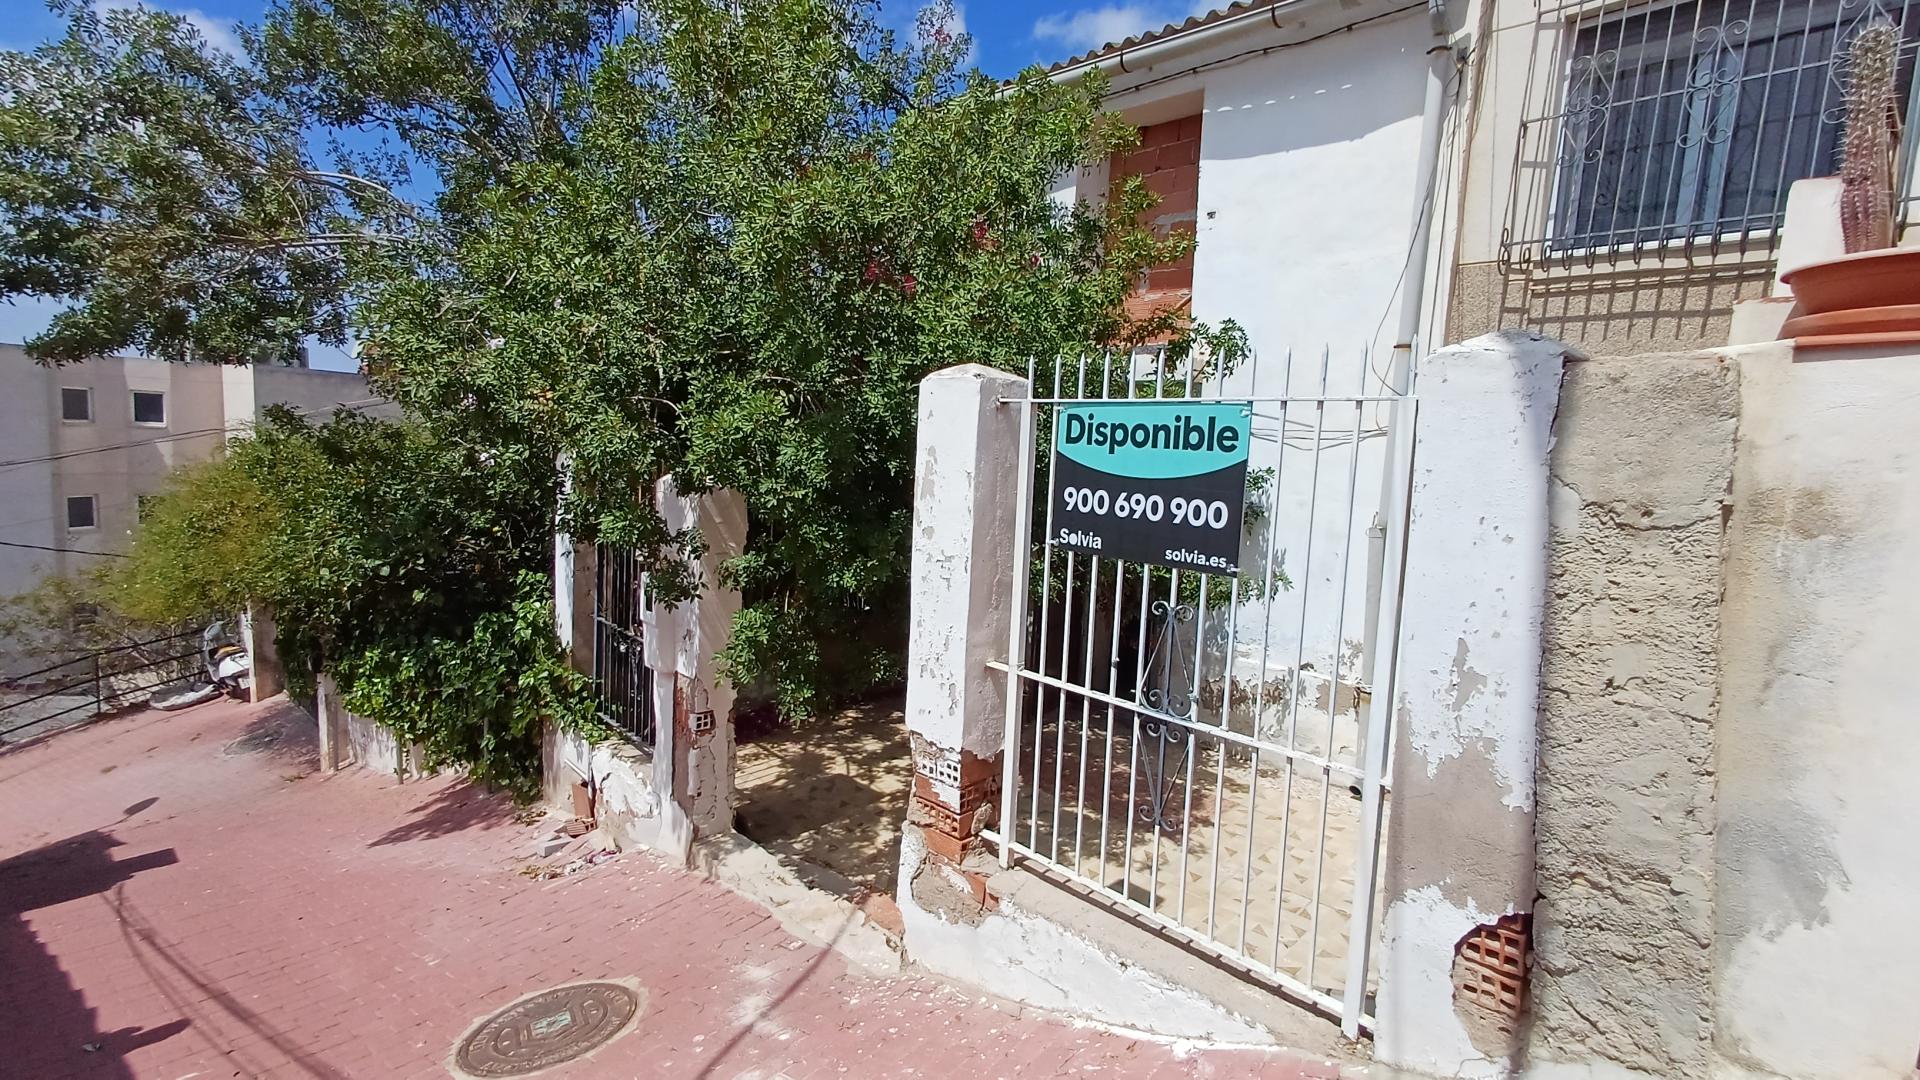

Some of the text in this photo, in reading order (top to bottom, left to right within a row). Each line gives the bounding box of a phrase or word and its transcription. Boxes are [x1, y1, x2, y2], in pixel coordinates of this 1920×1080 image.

[1065, 413, 1239, 454] Disponible
[1063, 486, 1229, 530] 900 690 900
[1059, 528, 1102, 550] Solvia
[1164, 548, 1227, 568] solvia.es
